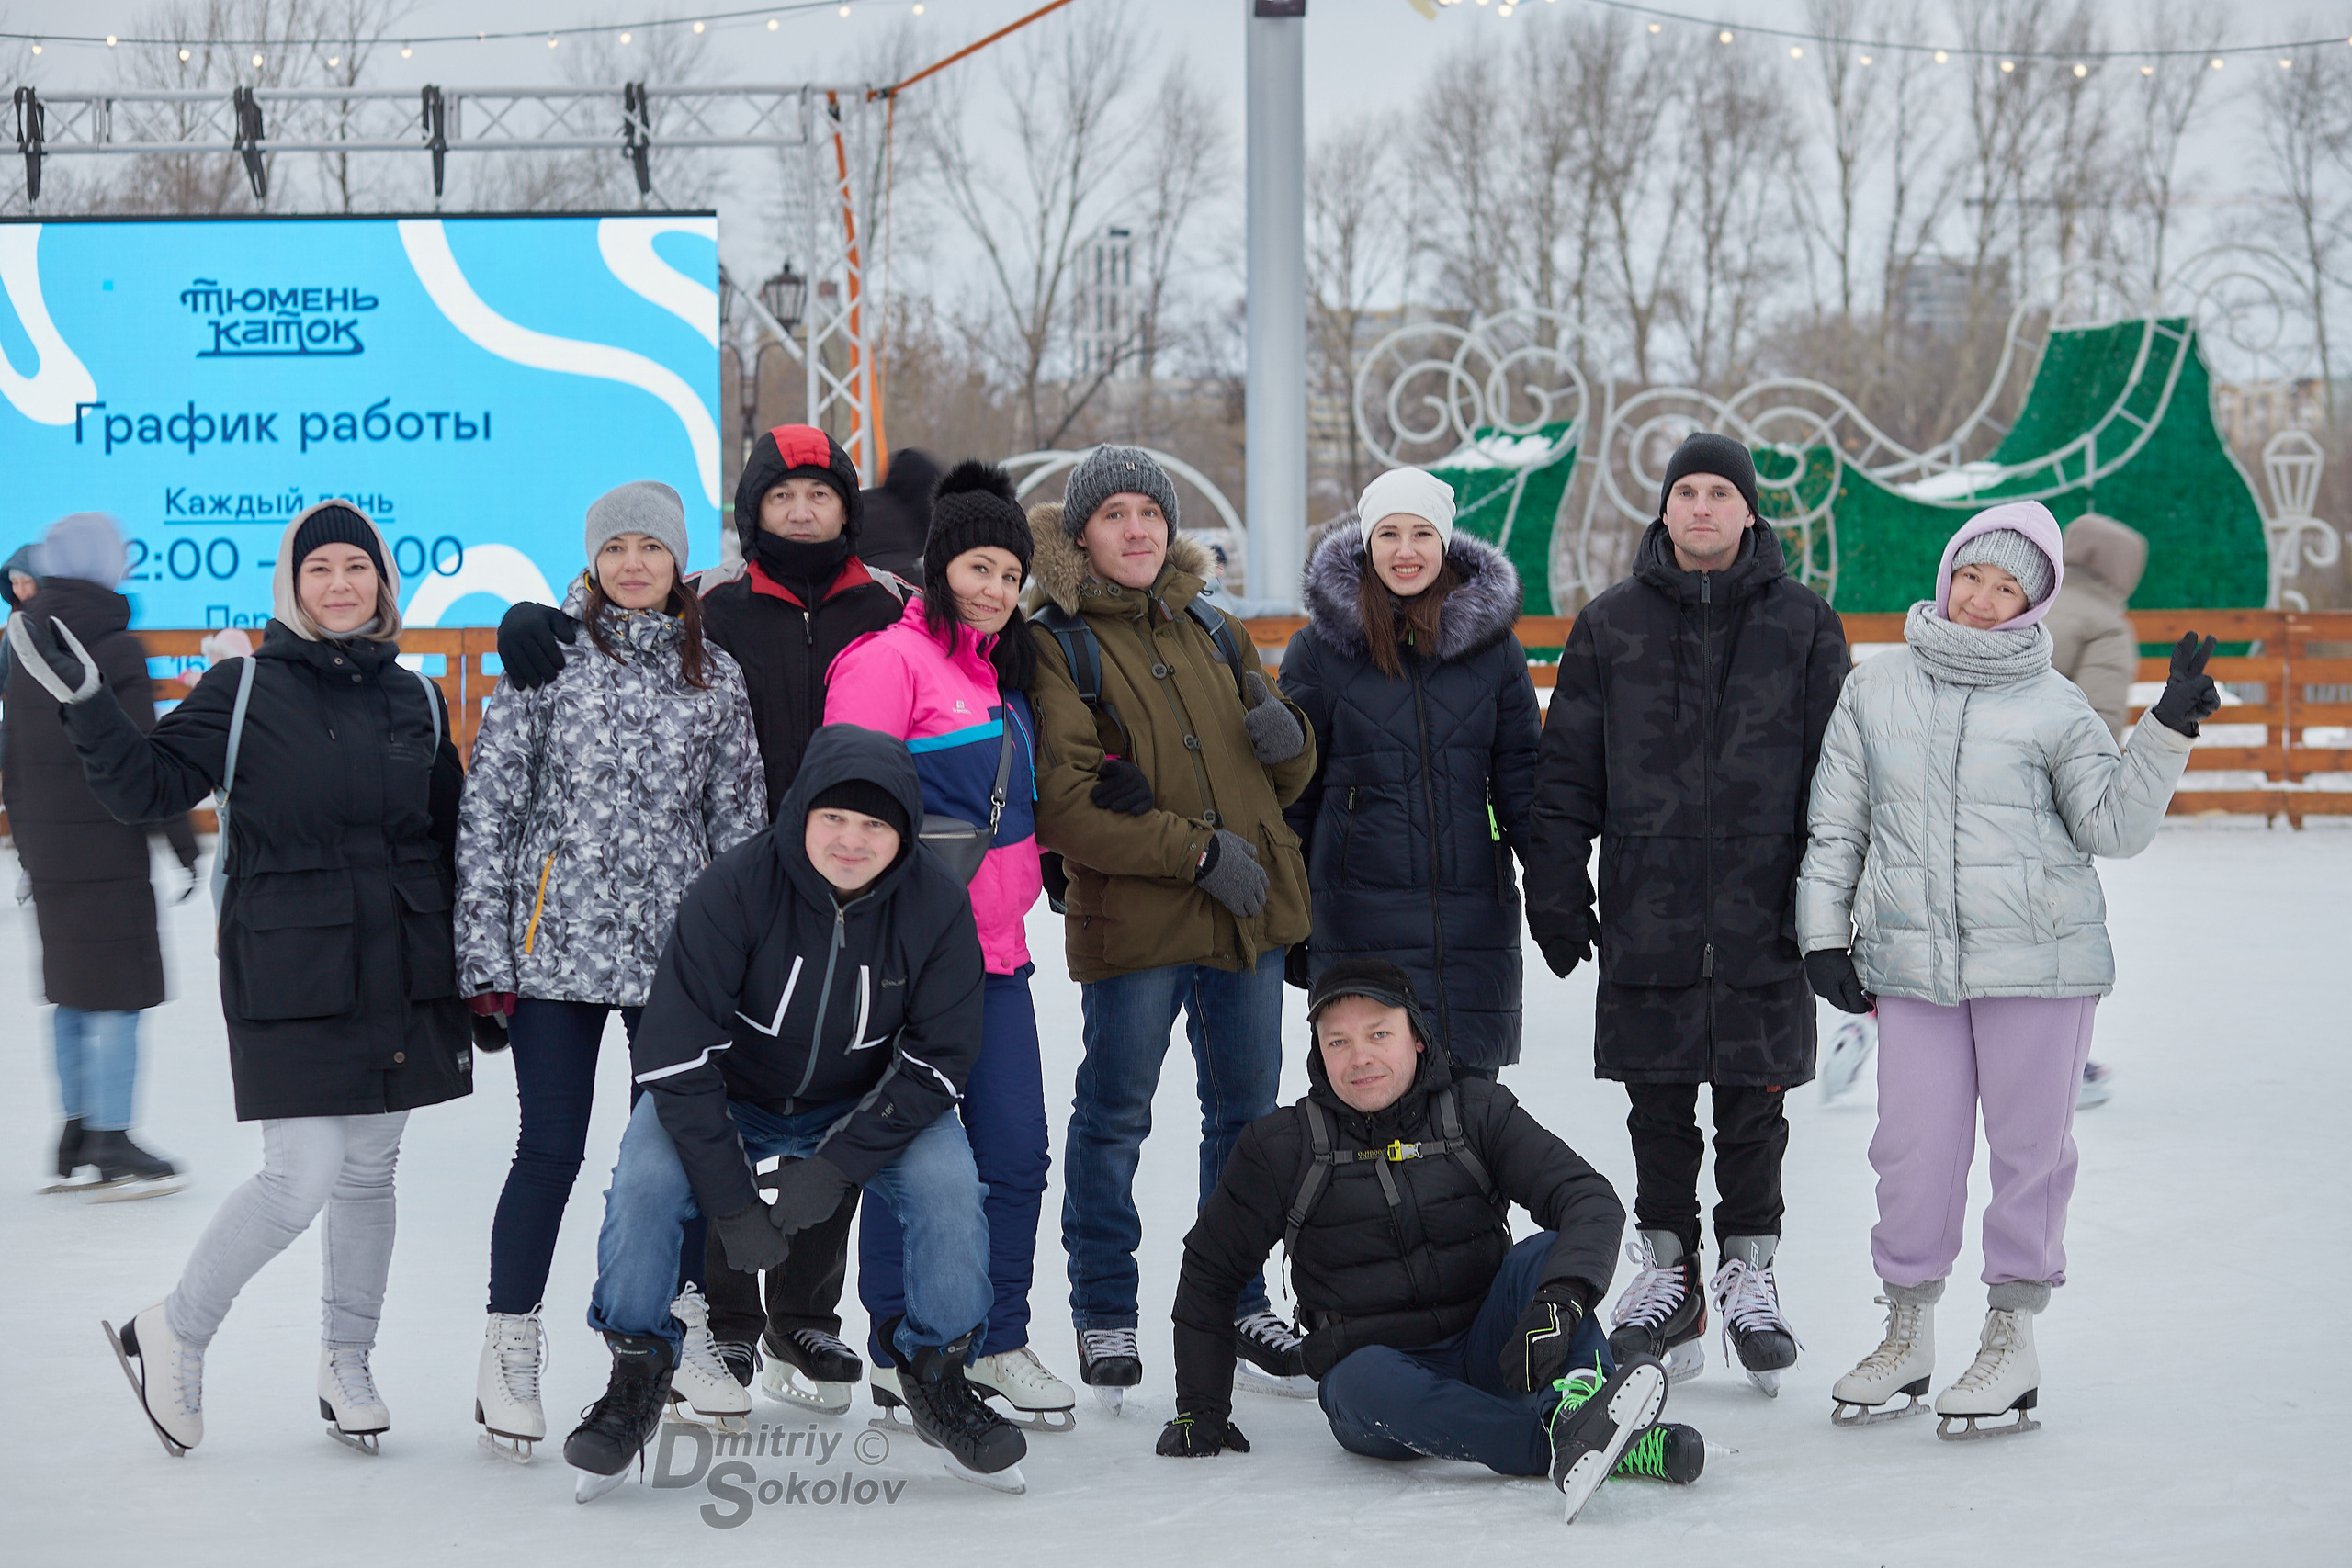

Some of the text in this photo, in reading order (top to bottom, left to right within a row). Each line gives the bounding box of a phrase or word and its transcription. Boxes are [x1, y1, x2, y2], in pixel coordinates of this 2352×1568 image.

[75, 397, 492, 454] График работы
[166, 487, 394, 518] Каждый нь
[126, 537, 240, 580] 2:00
